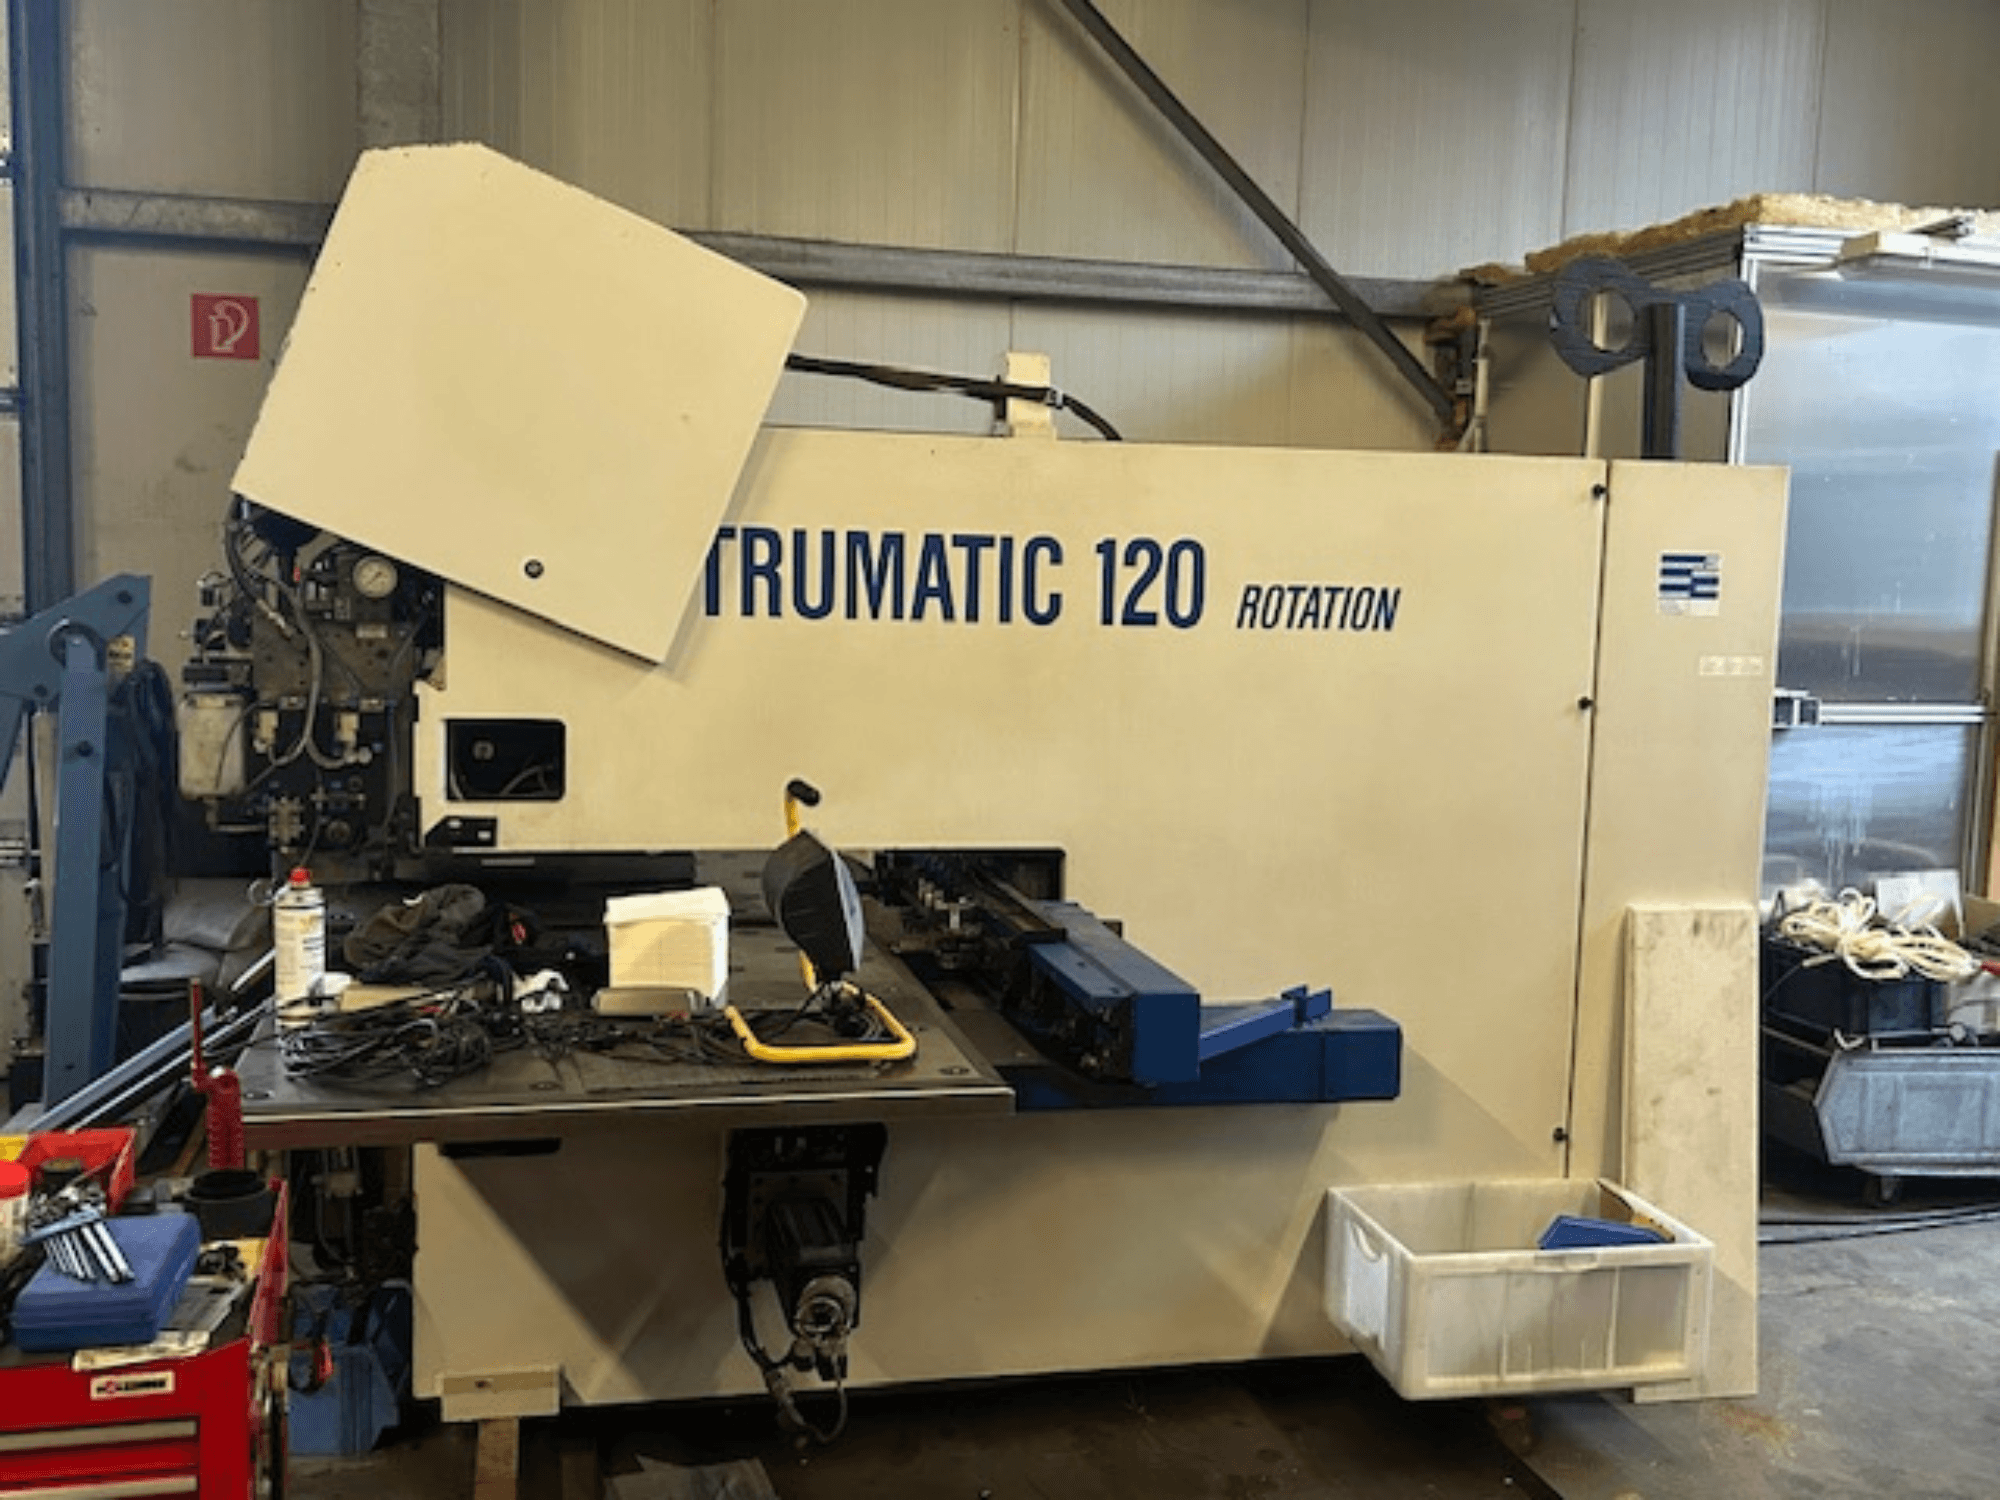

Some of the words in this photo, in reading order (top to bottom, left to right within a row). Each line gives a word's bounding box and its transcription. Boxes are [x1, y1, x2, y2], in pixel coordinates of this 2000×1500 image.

[705, 526, 1063, 626] TRUMATIC
[1096, 538, 1205, 629] 120
[1236, 584, 1400, 631] ROTATION
